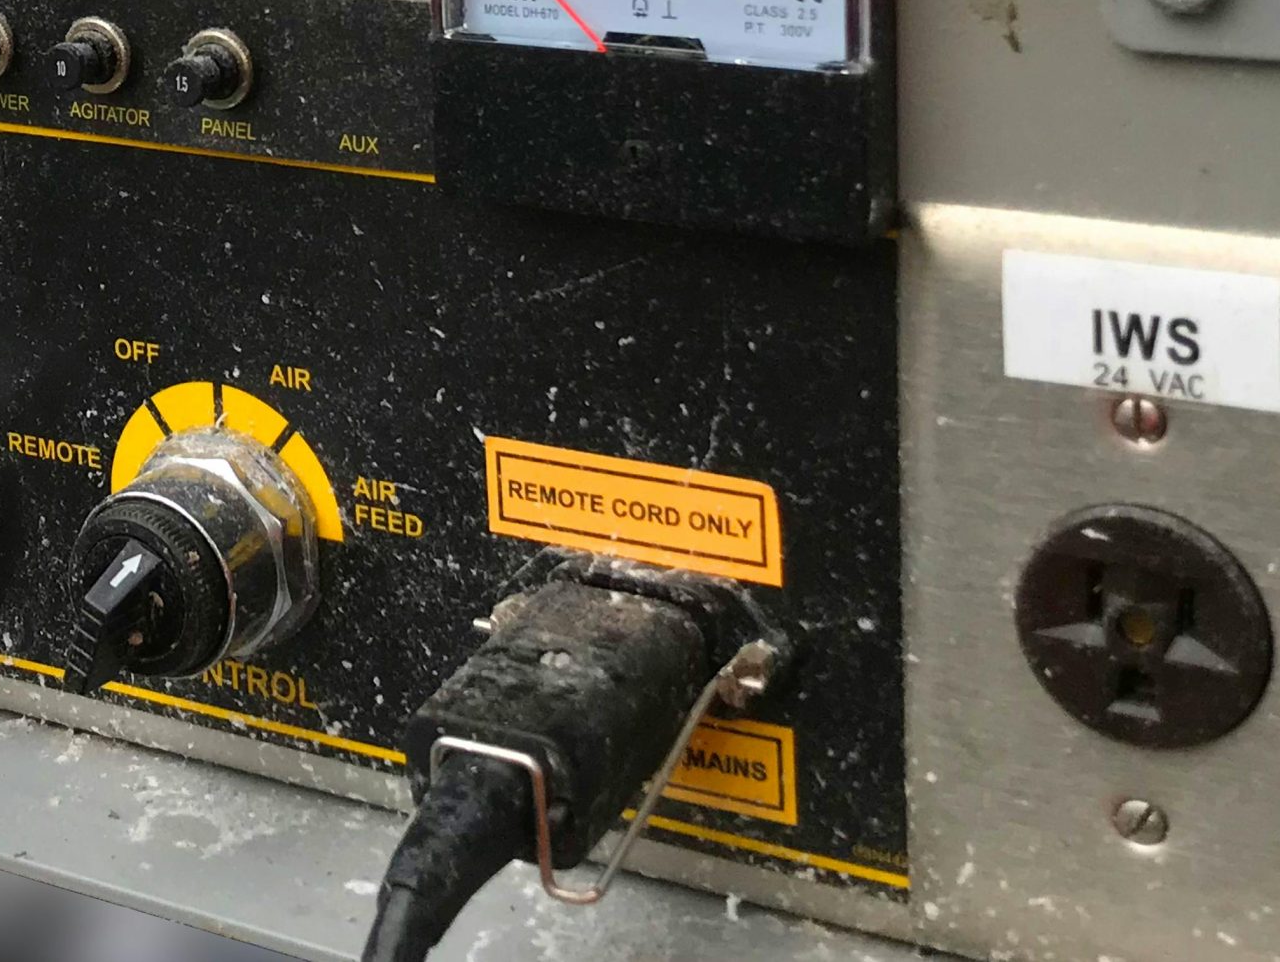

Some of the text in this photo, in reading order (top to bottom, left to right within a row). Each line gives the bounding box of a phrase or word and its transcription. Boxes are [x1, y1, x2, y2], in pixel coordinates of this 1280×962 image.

[484, 4, 520, 18] MODEL
[743, 4, 788, 19] CLASS
[56, 60, 66, 76] 10
[70, 101, 151, 128] AGITATOR
[201, 117, 256, 141] PANEL
[338, 133, 379, 155] AUX
[114, 337, 160, 364] OFF
[1093, 309, 1201, 366] IWS
[270, 365, 312, 391] AIR
[1093, 363, 1205, 399] 24 VAC
[8, 432, 101, 469] REMOTE
[353, 476, 397, 502] AIR
[354, 503, 424, 538] FEED
[508, 479, 753, 539] REMOTE CORD ONLY
[202, 659, 318, 710] NTROL
[685, 748, 768, 781] MAINS
